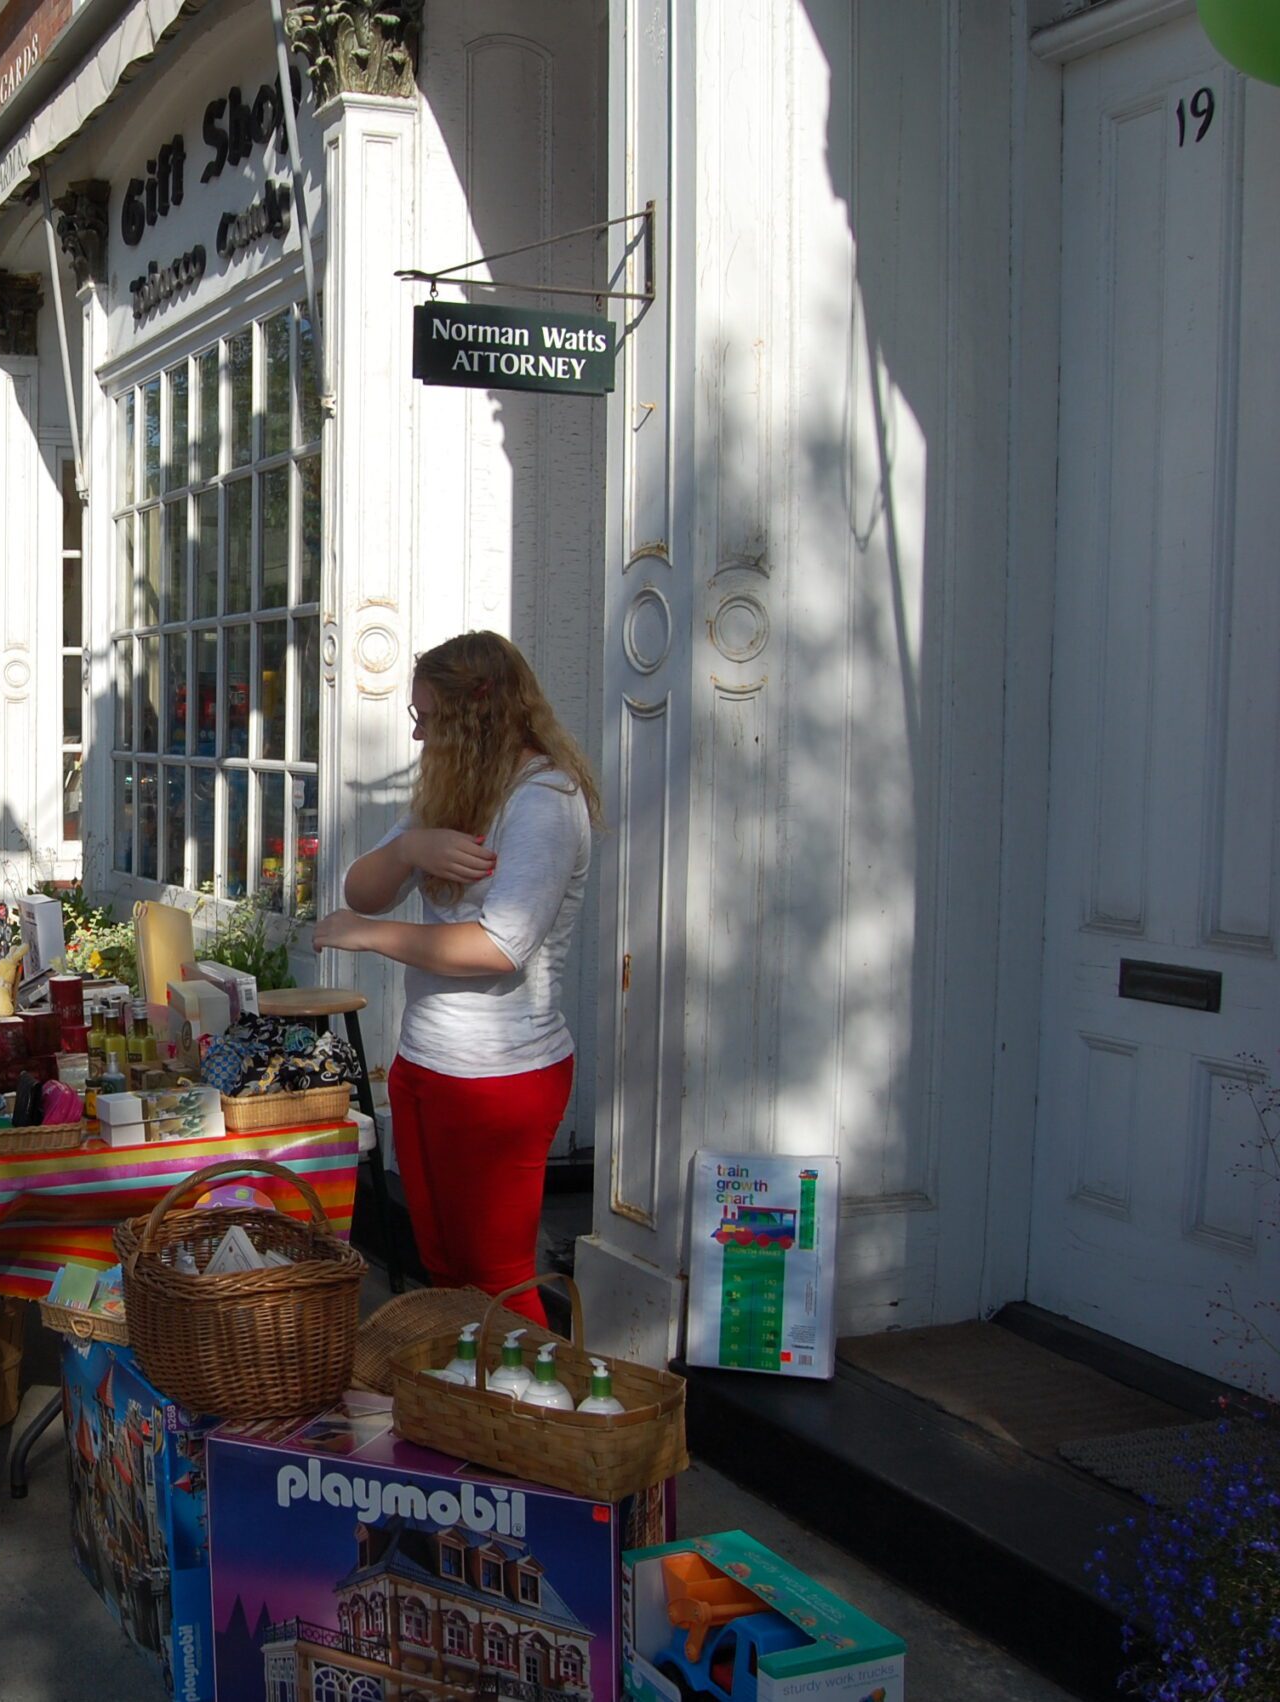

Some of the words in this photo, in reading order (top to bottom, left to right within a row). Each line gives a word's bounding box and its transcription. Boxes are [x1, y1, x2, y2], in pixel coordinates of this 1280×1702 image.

[0, 33, 39, 105] CARDS
[1176, 87, 1216, 147] 19
[121, 133, 187, 246] Gift
[200, 65, 302, 183] Shop
[431, 318, 530, 347] Norman
[541, 326, 607, 353] Watts
[451, 349, 587, 380] ATTORNEY
[716, 1179, 768, 1193] growth
[717, 1164, 749, 1178] train
[716, 1192, 754, 1206] chart
[277, 1458, 526, 1538] playmobil
[178, 1624, 200, 1702] playmobil
[783, 1679, 821, 1696] sturdy
[825, 1672, 855, 1688] work
[858, 1663, 895, 1682] trucks
